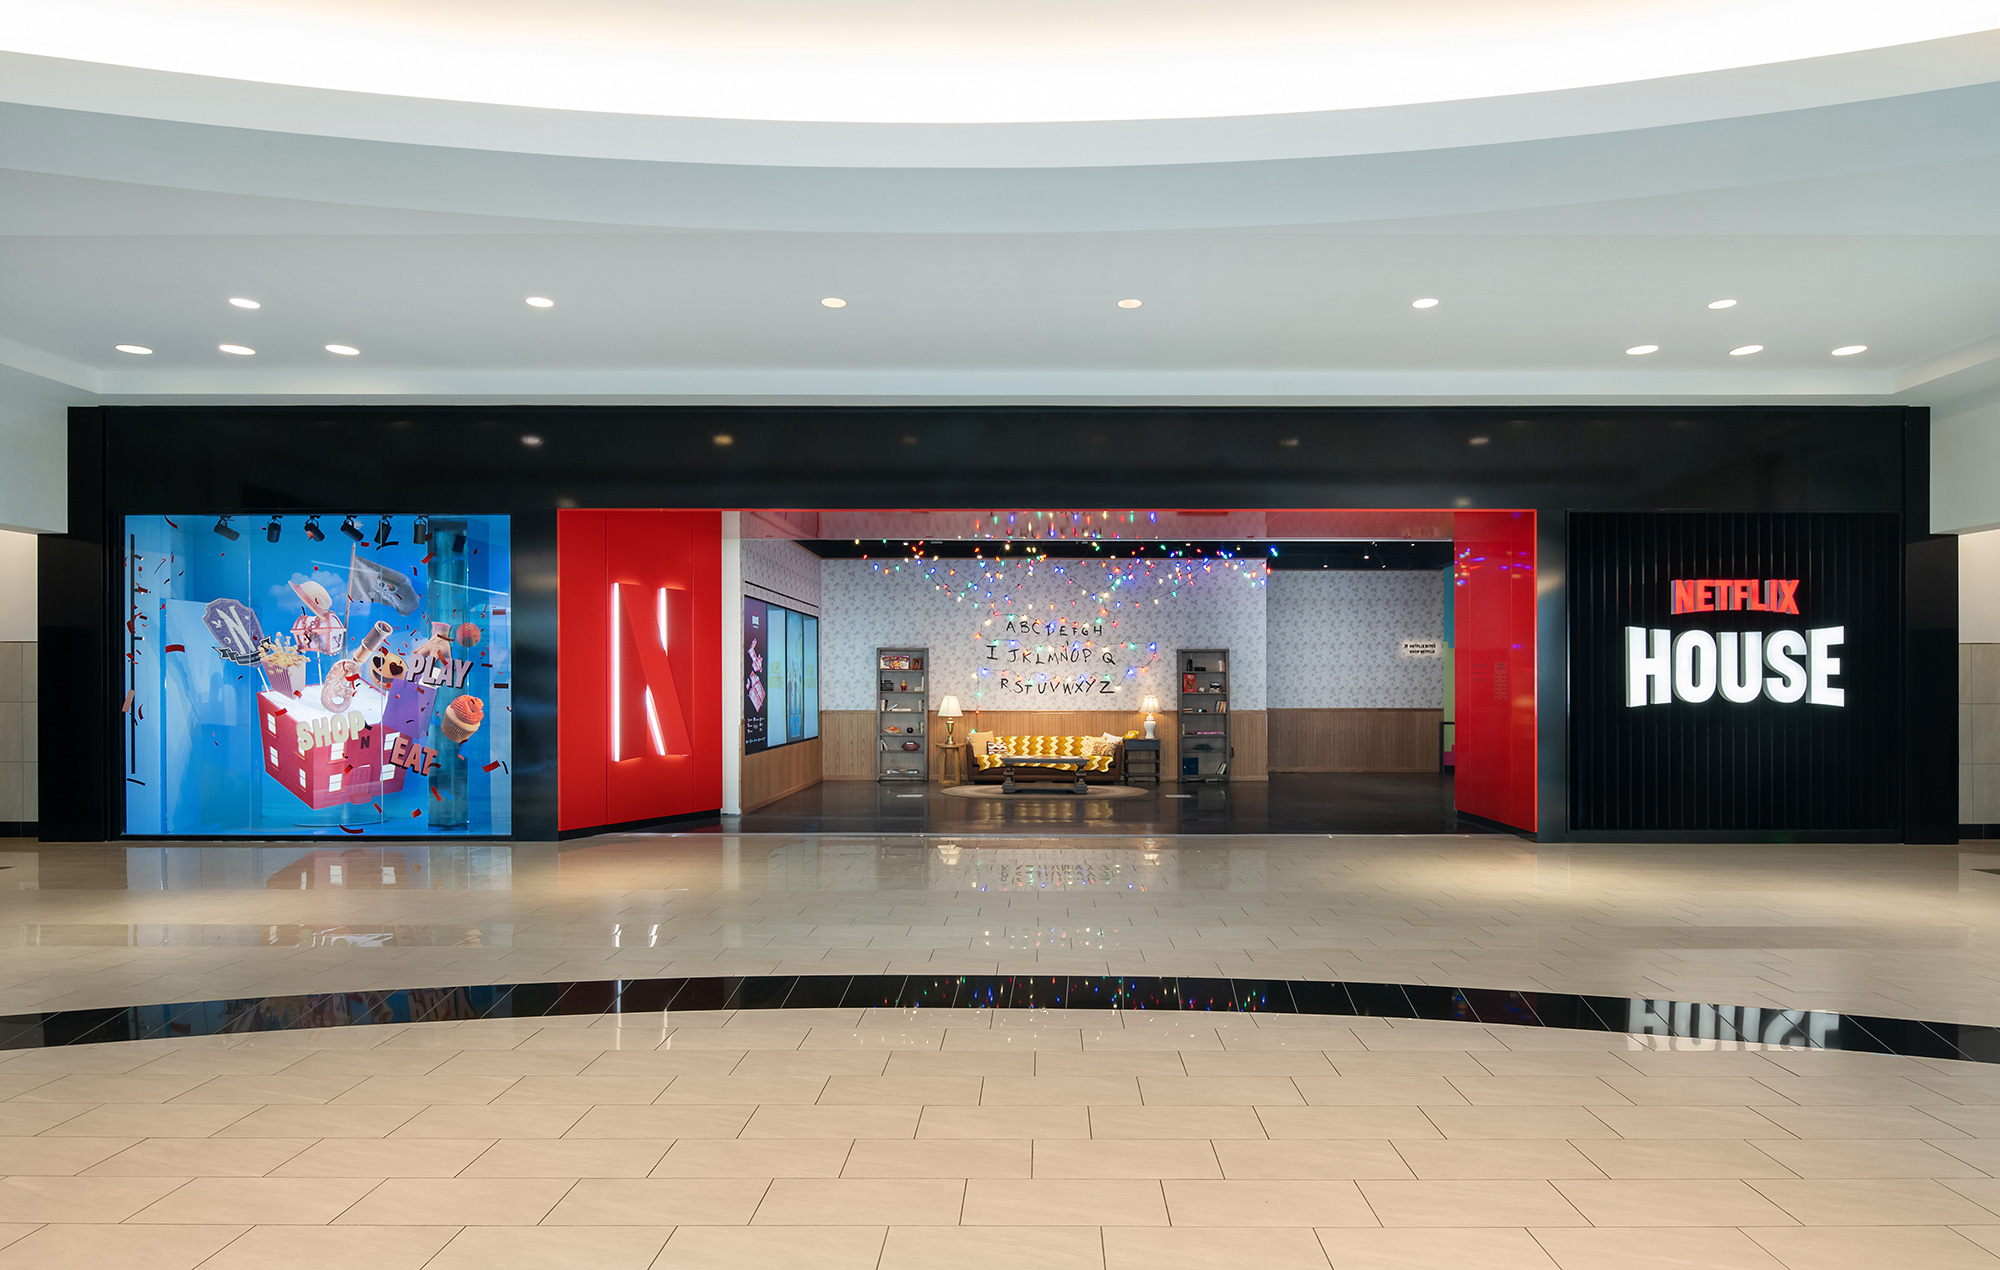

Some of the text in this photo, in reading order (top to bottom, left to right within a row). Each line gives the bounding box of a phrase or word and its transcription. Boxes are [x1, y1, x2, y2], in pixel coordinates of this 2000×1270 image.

[1671, 579, 1800, 615] NETFLIX
[406, 653, 473, 689] PLAY
[1625, 625, 1845, 708] HOUSE
[296, 711, 366, 751] SHOP
[360, 735, 371, 749] N
[389, 736, 439, 776] EAT
